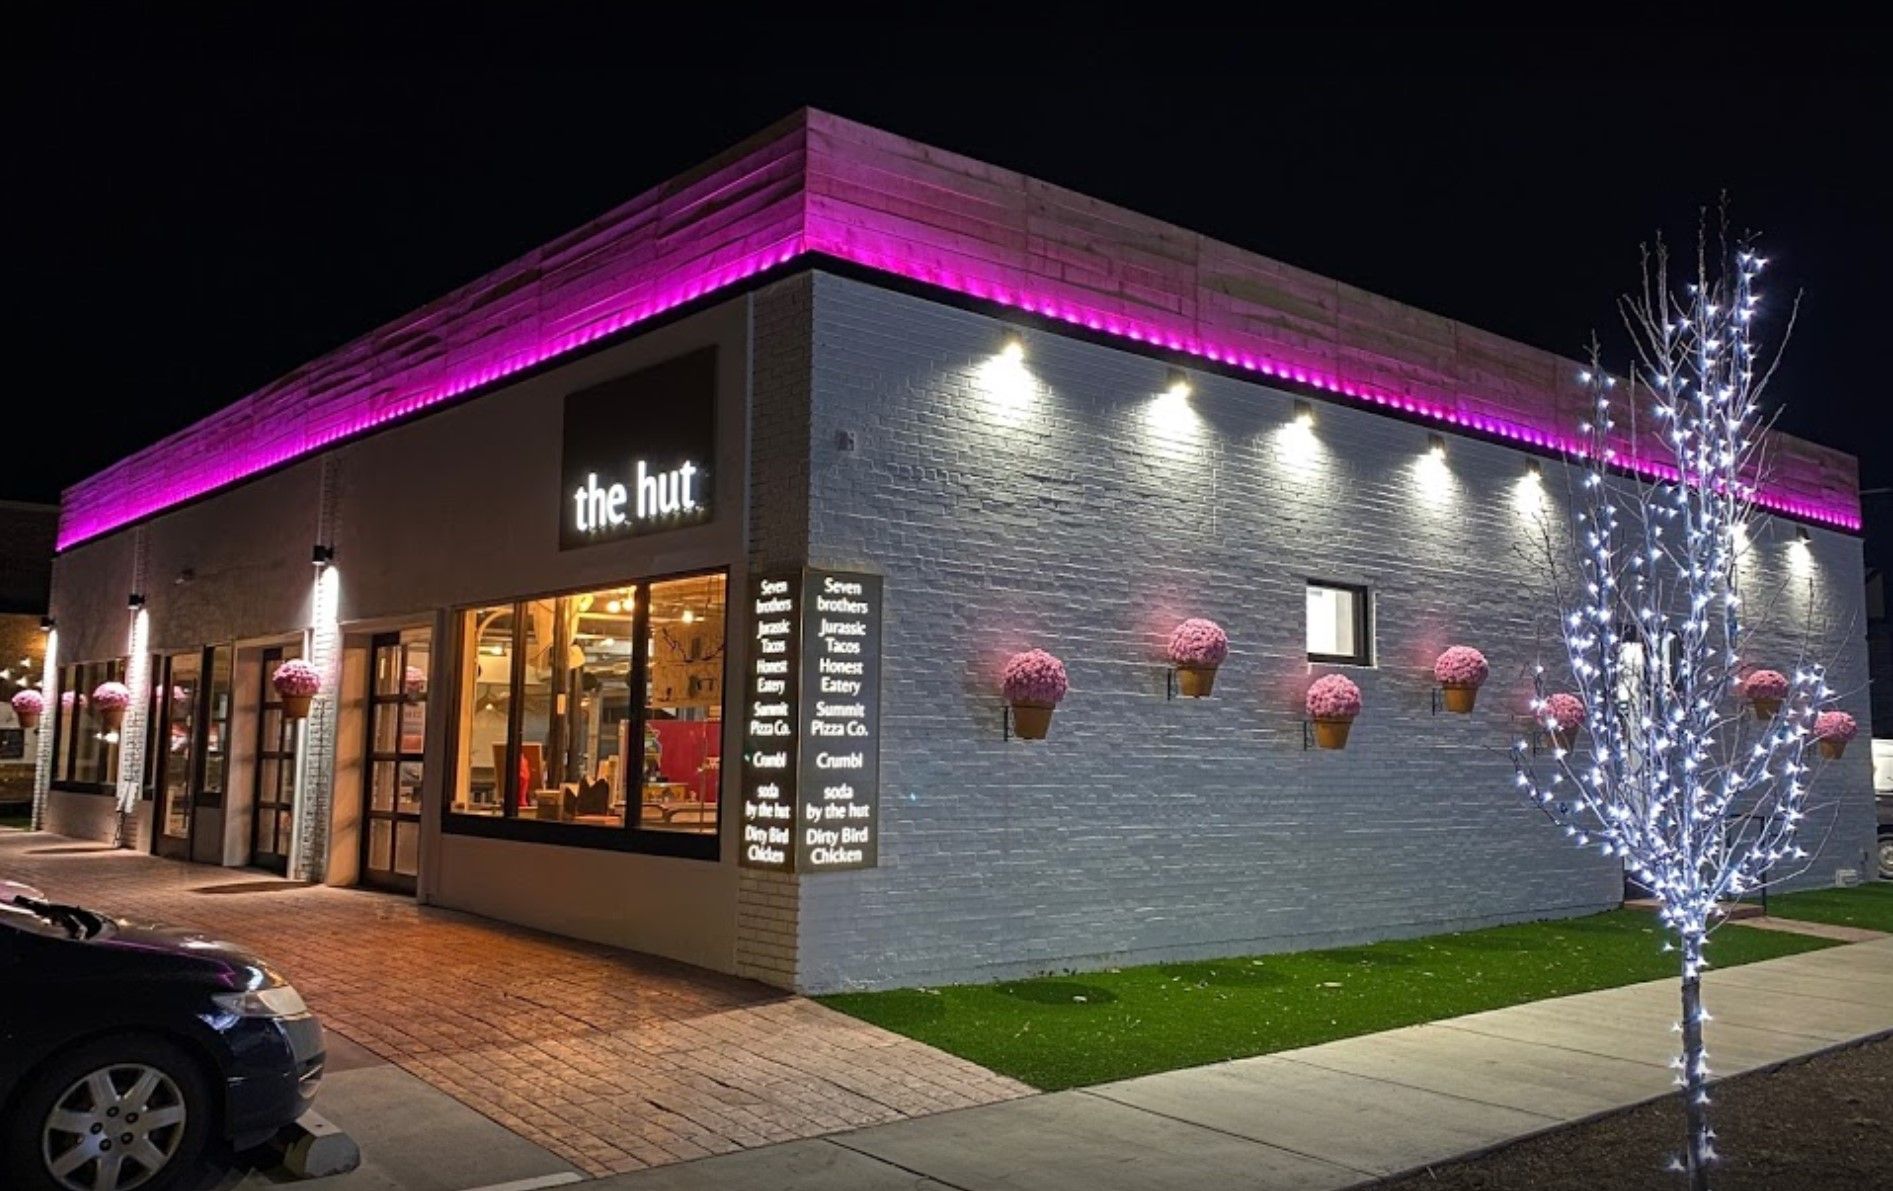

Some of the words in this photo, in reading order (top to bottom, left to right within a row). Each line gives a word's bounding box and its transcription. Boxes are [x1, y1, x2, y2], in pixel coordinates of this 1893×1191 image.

[574, 473, 627, 531] the
[637, 460, 697, 518] hut
[823, 577, 862, 596] Seven
[816, 595, 869, 614] brothers
[818, 618, 867, 637] Jurassic
[825, 636, 861, 654] Tacos
[819, 658, 864, 675] Honest
[821, 676, 861, 697] Eatery
[816, 700, 865, 718] Summit
[810, 719, 845, 737] Pizza
[846, 720, 869, 737] Co.
[815, 752, 863, 769] Crumbl
[757, 782, 780, 799] soda
[823, 783, 854, 800] soda
[745, 800, 758, 820] by
[805, 802, 823, 823] by
[824, 802, 847, 819] the
[848, 802, 870, 818] hut
[805, 828, 839, 847] Dirty
[841, 826, 869, 844] Bird
[811, 847, 863, 865] Chicken
